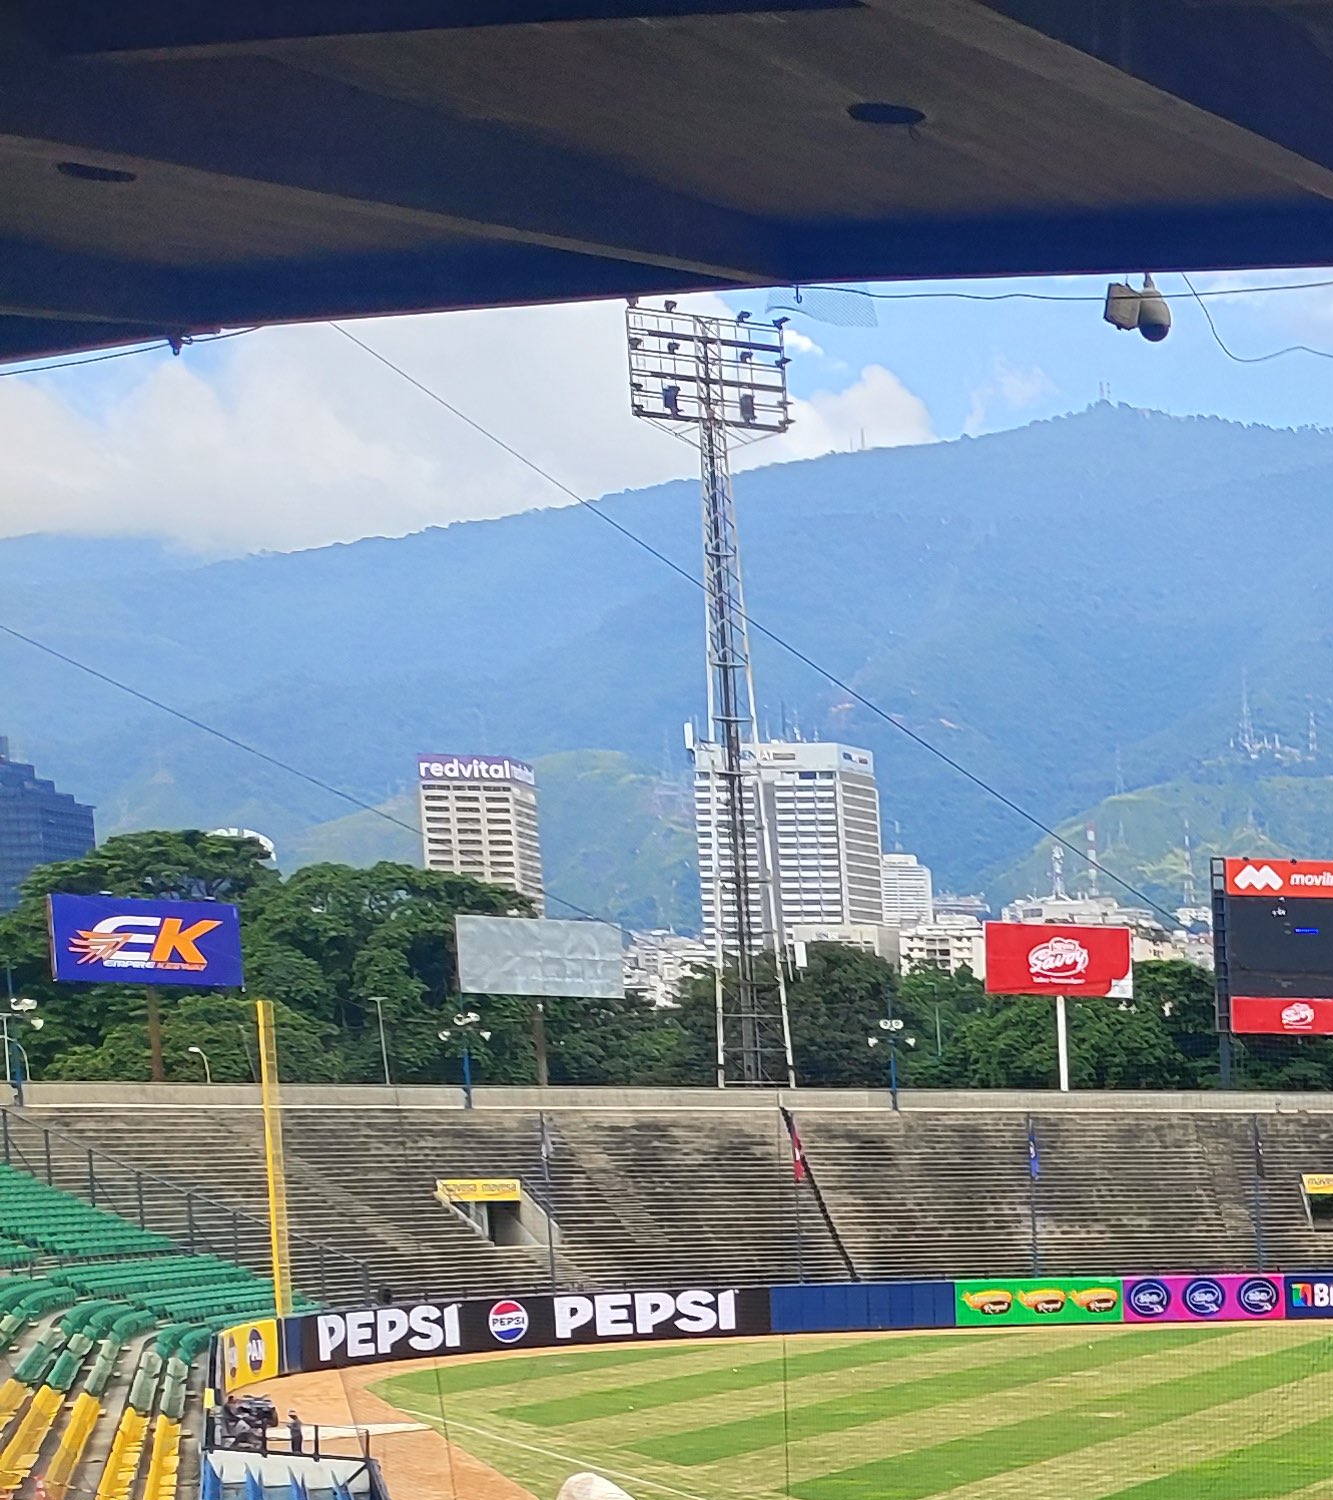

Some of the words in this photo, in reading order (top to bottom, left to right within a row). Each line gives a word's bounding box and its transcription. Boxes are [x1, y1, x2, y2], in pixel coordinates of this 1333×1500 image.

[419, 758, 511, 779] redvital
[491, 1316, 525, 1327] PEPSI
[554, 1289, 737, 1339] PEPSI
[317, 1304, 461, 1361] PEPSI
